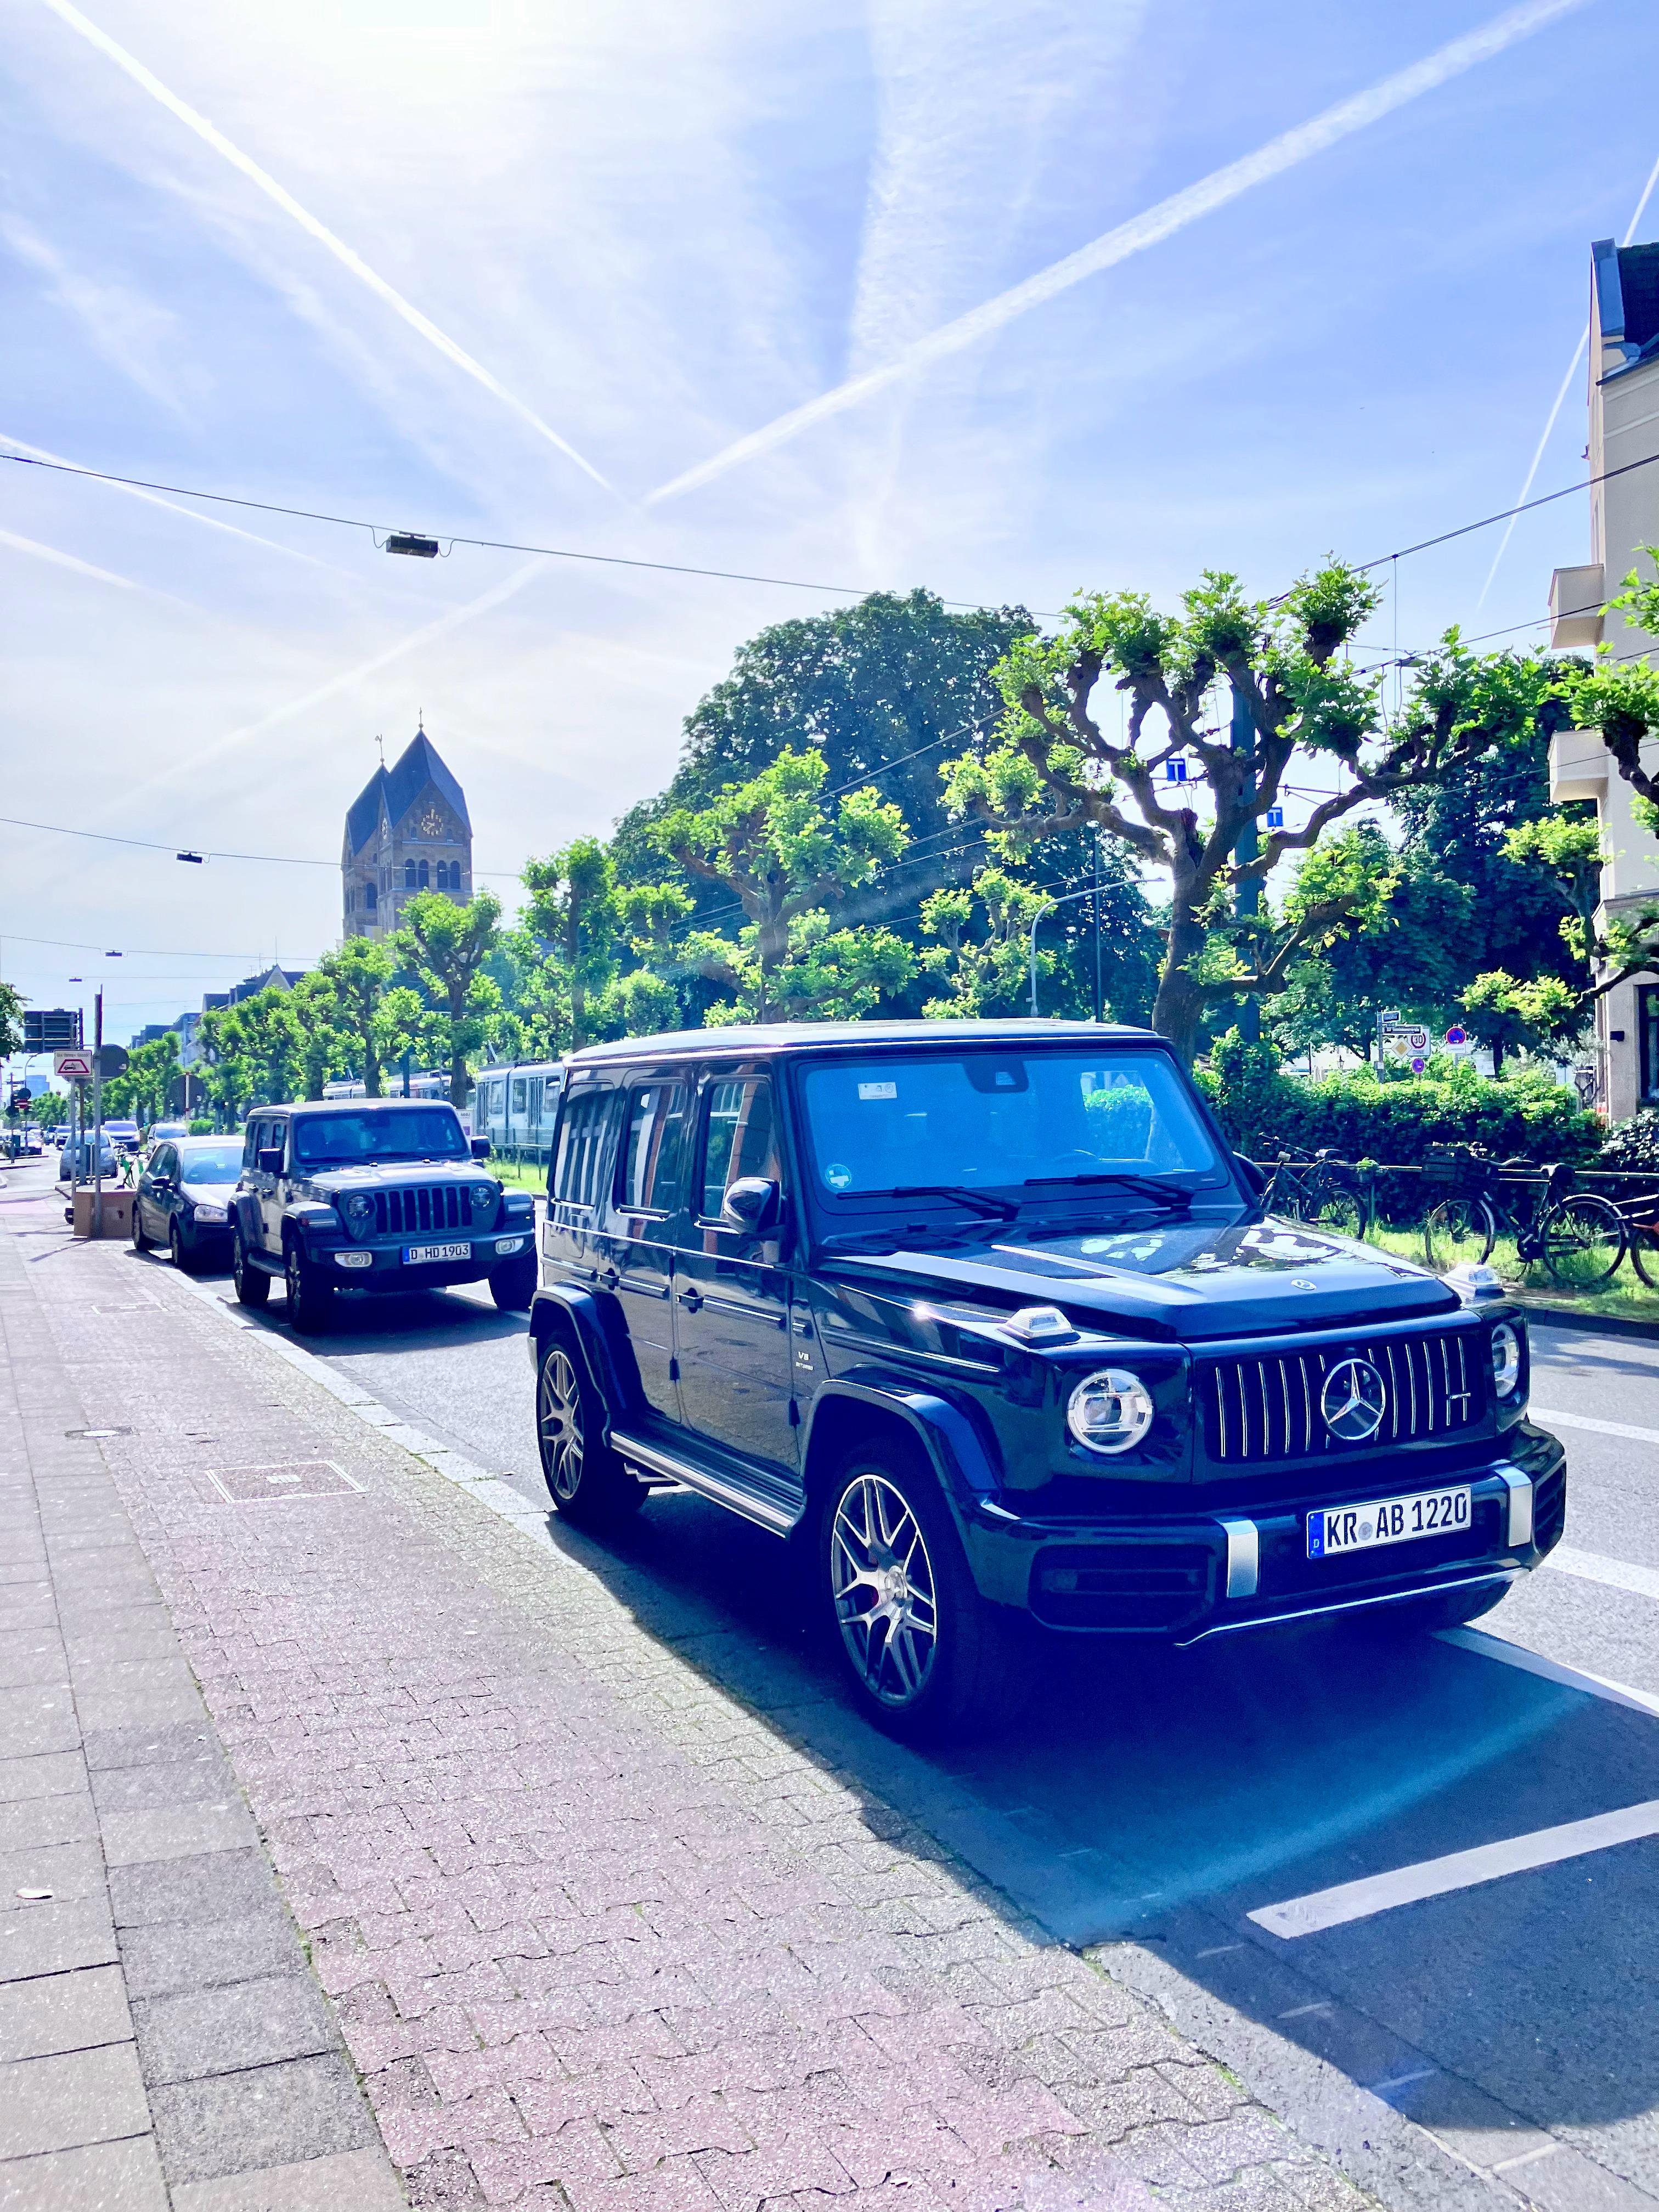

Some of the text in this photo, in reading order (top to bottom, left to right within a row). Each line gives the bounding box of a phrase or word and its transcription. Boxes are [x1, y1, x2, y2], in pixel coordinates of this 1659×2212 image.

[1414, 1035, 1423, 1043] 30
[411, 1245, 469, 1259] D HD 1903
[1328, 1493, 1467, 1547] KR AB 1220
[1313, 1539, 1319, 1548] D
